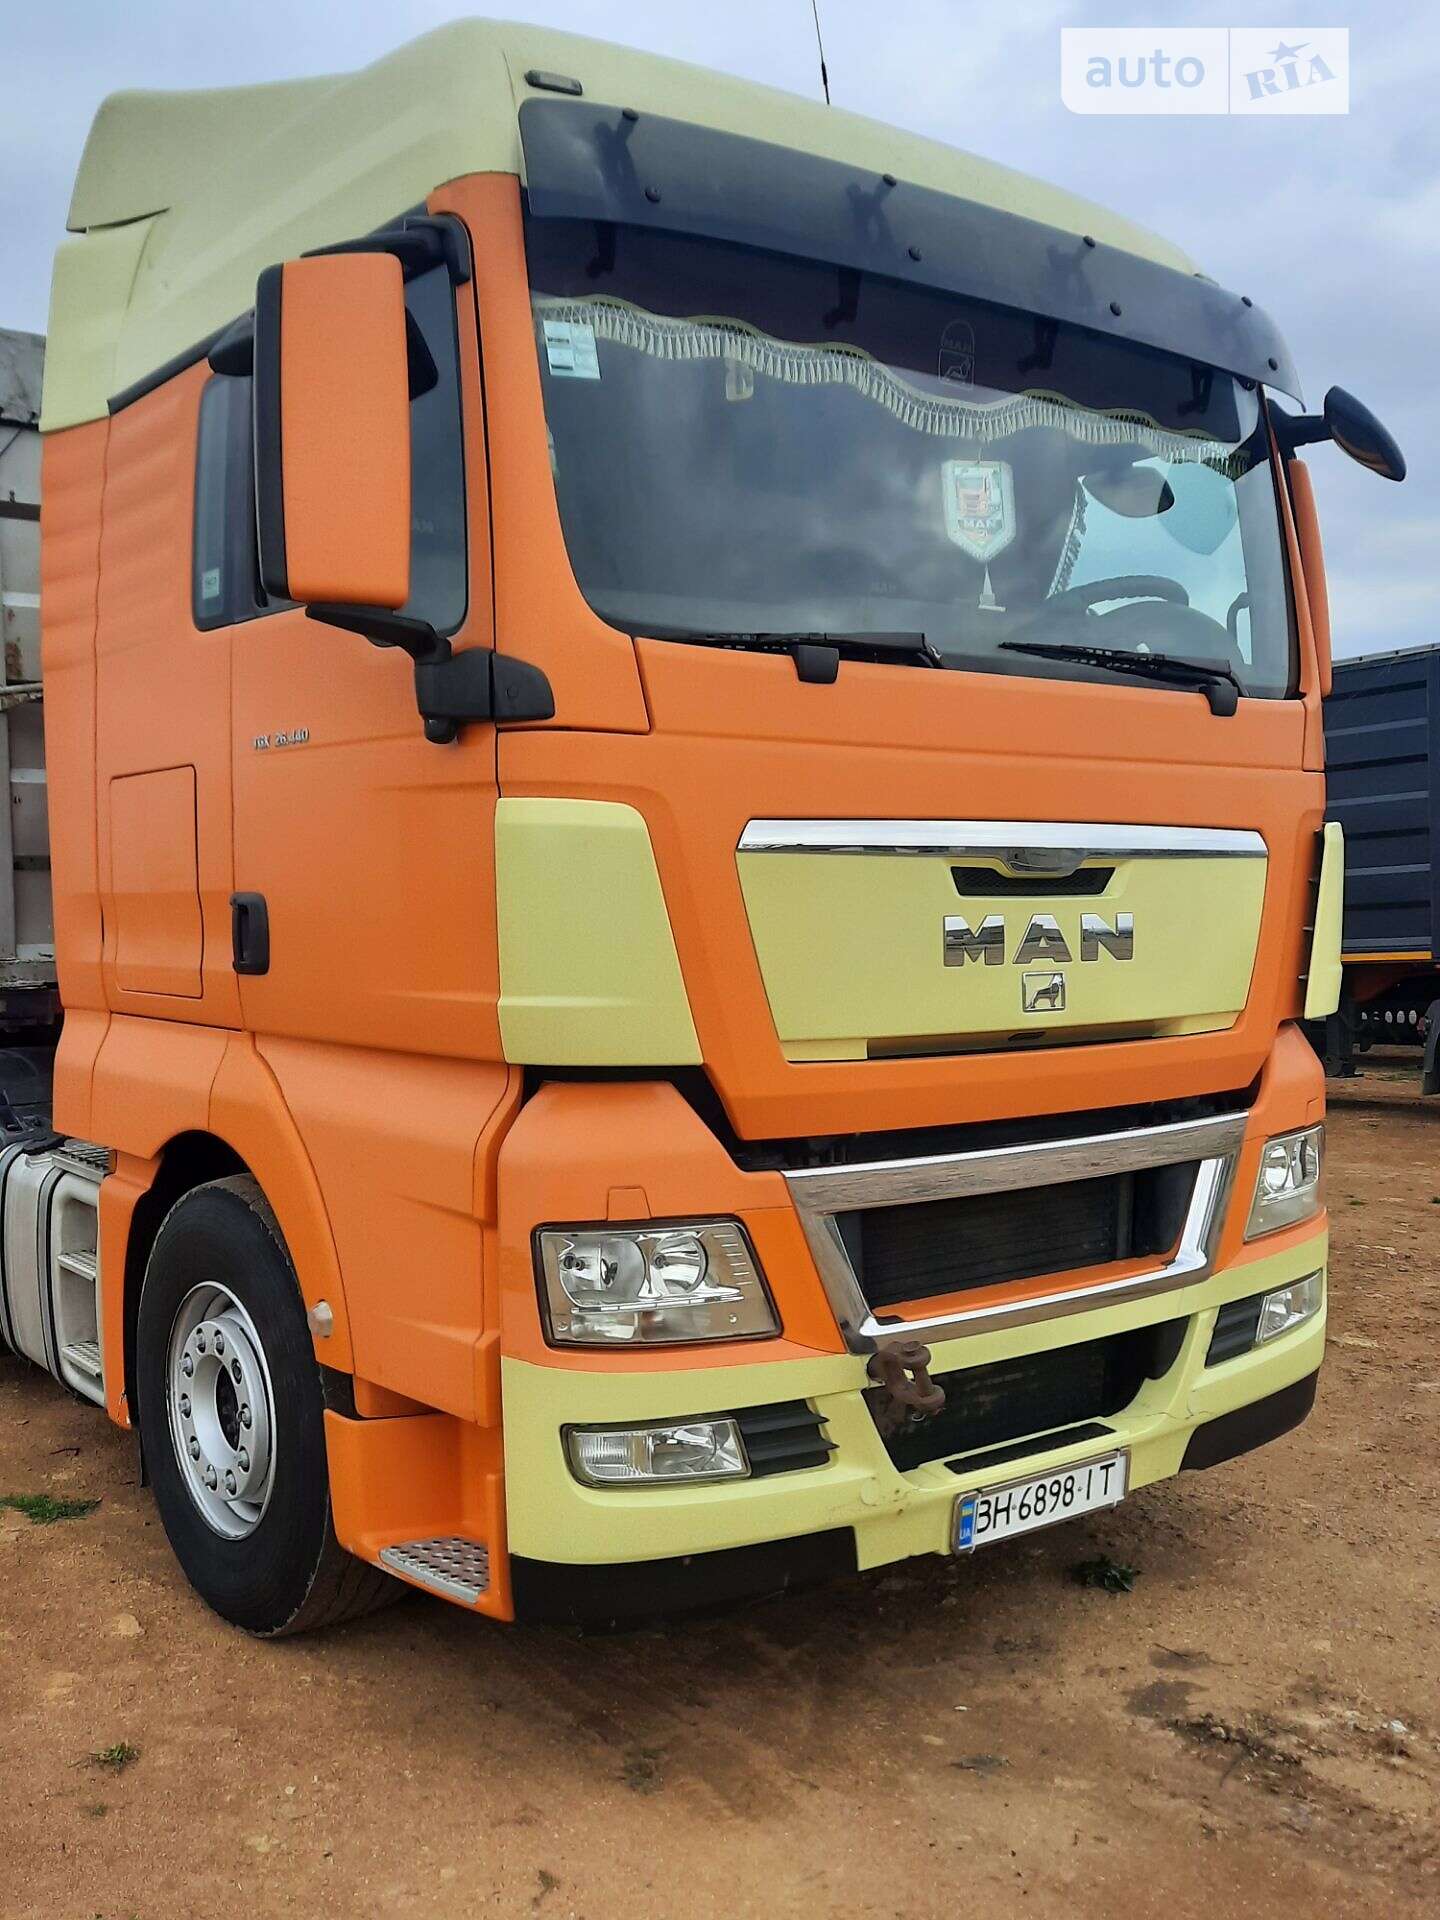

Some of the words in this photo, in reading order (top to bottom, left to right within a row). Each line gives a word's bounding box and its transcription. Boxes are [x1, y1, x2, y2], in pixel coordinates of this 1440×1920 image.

[963, 518, 996, 530] MAN
[943, 912, 1134, 967] MAN
[959, 1527, 972, 1540] UA
[1018, 1475, 1075, 1521] 6898
[1086, 1462, 1116, 1501] IT
